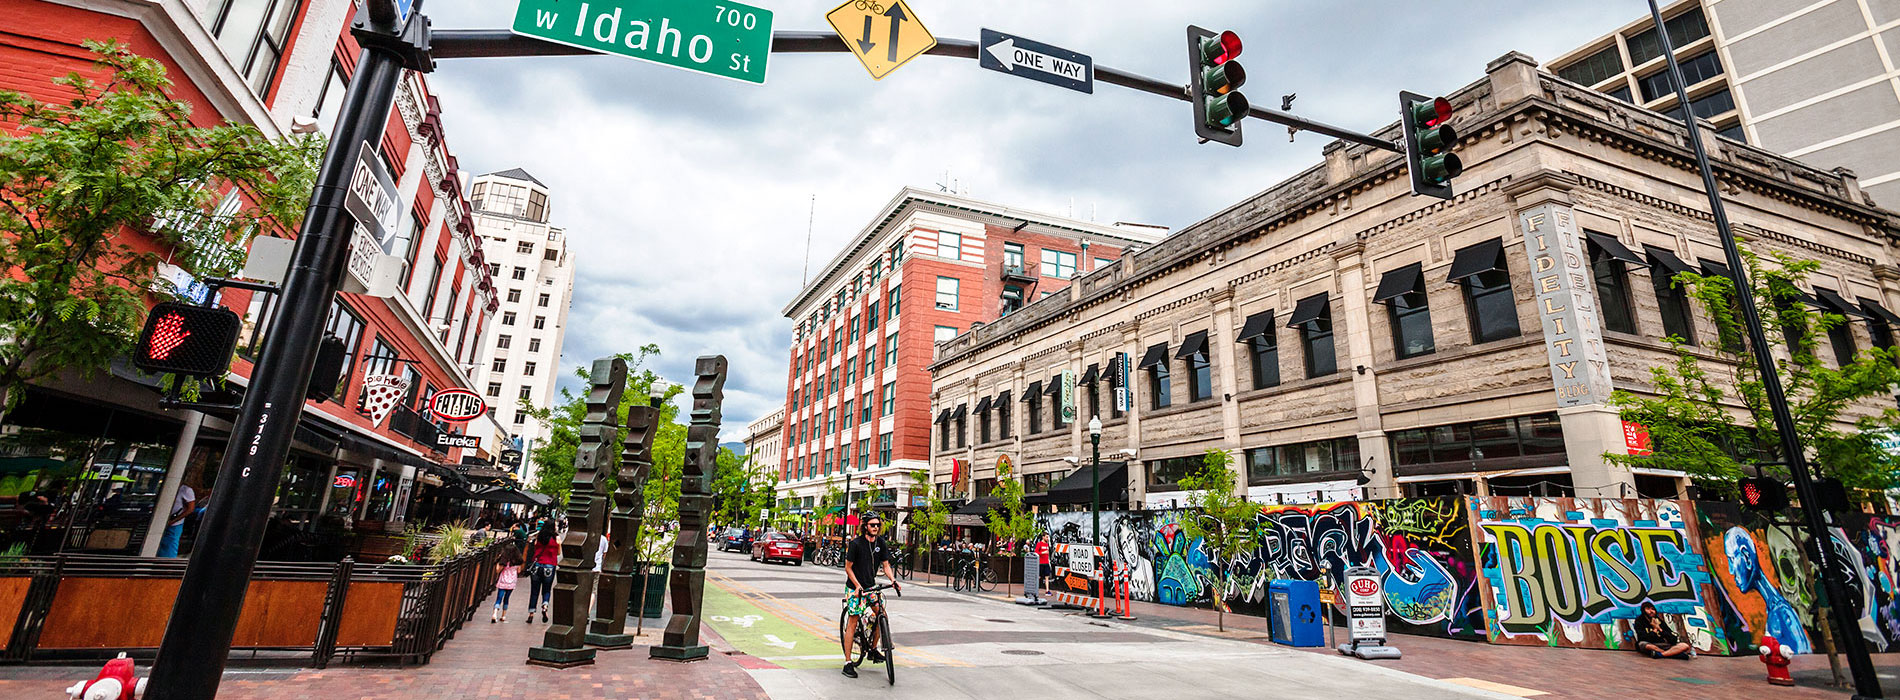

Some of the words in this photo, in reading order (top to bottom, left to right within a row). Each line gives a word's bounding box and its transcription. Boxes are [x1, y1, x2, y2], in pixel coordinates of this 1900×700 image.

[715, 5, 757, 30] 700
[574, 2, 714, 64] Idaho
[729, 53, 751, 73] St
[1014, 50, 1043, 69] ONE
[1052, 59, 1081, 78] WAY
[355, 165, 377, 208] ONE
[373, 189, 392, 226] WAY
[358, 235, 379, 262] EXCEPT
[351, 251, 373, 284] BICYCLES
[1525, 213, 1579, 380] FIDELITY
[1555, 211, 1605, 378] FIDELITY
[435, 393, 481, 416] FATTYS
[1558, 383, 1589, 399] BLDG
[249, 413, 268, 456] 3129
[437, 434, 480, 448] Eureka!
[1071, 561, 1092, 572] CLOSED
[1073, 548, 1089, 559] ROAD
[1069, 577, 1086, 588] DETOUR
[1351, 579, 1378, 592] GUHO
[1483, 525, 1697, 633] BOISE
